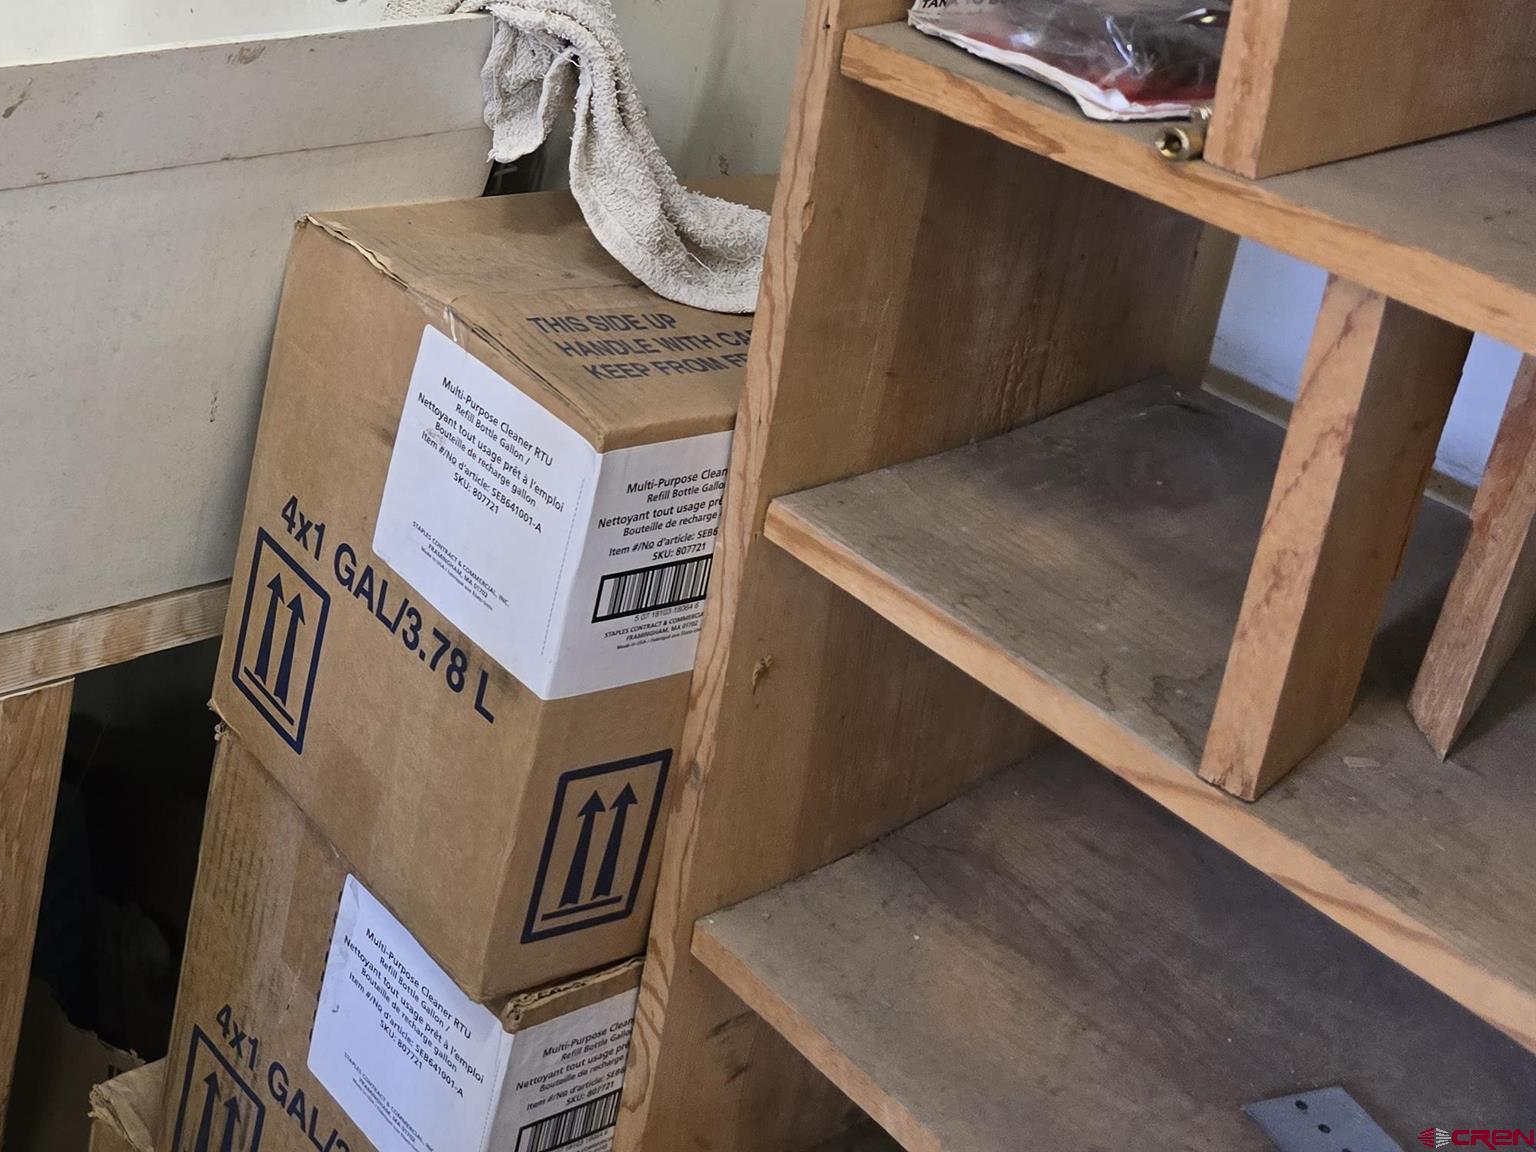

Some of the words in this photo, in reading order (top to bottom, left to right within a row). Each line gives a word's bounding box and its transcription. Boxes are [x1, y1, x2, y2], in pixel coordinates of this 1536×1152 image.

[526, 315, 591, 334] THIS
[585, 313, 648, 333] SIDE
[641, 312, 678, 330] UP
[555, 338, 661, 358] HANDLE
[652, 334, 723, 352] WITH
[582, 361, 652, 381] KEEP
[649, 357, 729, 377] FROM
[417, 392, 457, 430] Nettoyant
[458, 424, 476, 445] tout
[477, 440, 502, 465] usage
[502, 461, 522, 480] prêt
[522, 473, 528, 485] à
[442, 376, 499, 426] Multi-Purpose
[500, 422, 533, 452] Cleaner
[533, 446, 553, 467] RTU
[455, 403, 475, 424] Refill
[475, 418, 498, 442] Bottle
[499, 437, 524, 462] Gallon
[421, 430, 438, 450] Item
[491, 487, 542, 534] SEB641001-A
[434, 421, 466, 452] Bouteille
[467, 448, 477, 461] de
[477, 457, 511, 487] recharge
[511, 484, 536, 507] gallon
[626, 473, 698, 494] Multi-Purpose
[701, 467, 728, 480] Clean
[453, 472, 472, 492] SKU:
[472, 487, 499, 514] 807721
[597, 510, 650, 529] Nettoyant
[652, 506, 674, 519] tout
[676, 501, 706, 514] usage
[646, 489, 671, 503] Refill
[671, 485, 700, 499] Bottle
[622, 521, 664, 537] Bouteille
[665, 518, 677, 529] de
[678, 511, 718, 526] recharge
[608, 546, 630, 557] Item
[652, 549, 674, 561] SKU:
[675, 542, 706, 557] 807721
[281, 495, 326, 561] 4x1
[333, 542, 468, 693] GAL/3.78
[473, 670, 495, 724] L
[343, 935, 382, 980] Nettoyant
[383, 976, 399, 999] tout
[400, 996, 428, 1032] usage
[424, 1023, 442, 1044] prêt
[349, 972, 365, 993] Item
[365, 928, 420, 988] Multi-Purpose
[421, 985, 453, 1020] Cleaner
[453, 1017, 472, 1040] RTU
[379, 956, 398, 979] Refill
[397, 975, 420, 1002] Bottle
[420, 1000, 444, 1028] Gallon
[216, 1004, 259, 1072] 4x1
[361, 967, 391, 1003] Bouteille
[391, 1001, 401, 1014] de
[401, 1012, 433, 1048] recharge
[433, 1046, 457, 1073] gallon
[380, 1019, 396, 1042] SKU:
[397, 1038, 423, 1070] 807721
